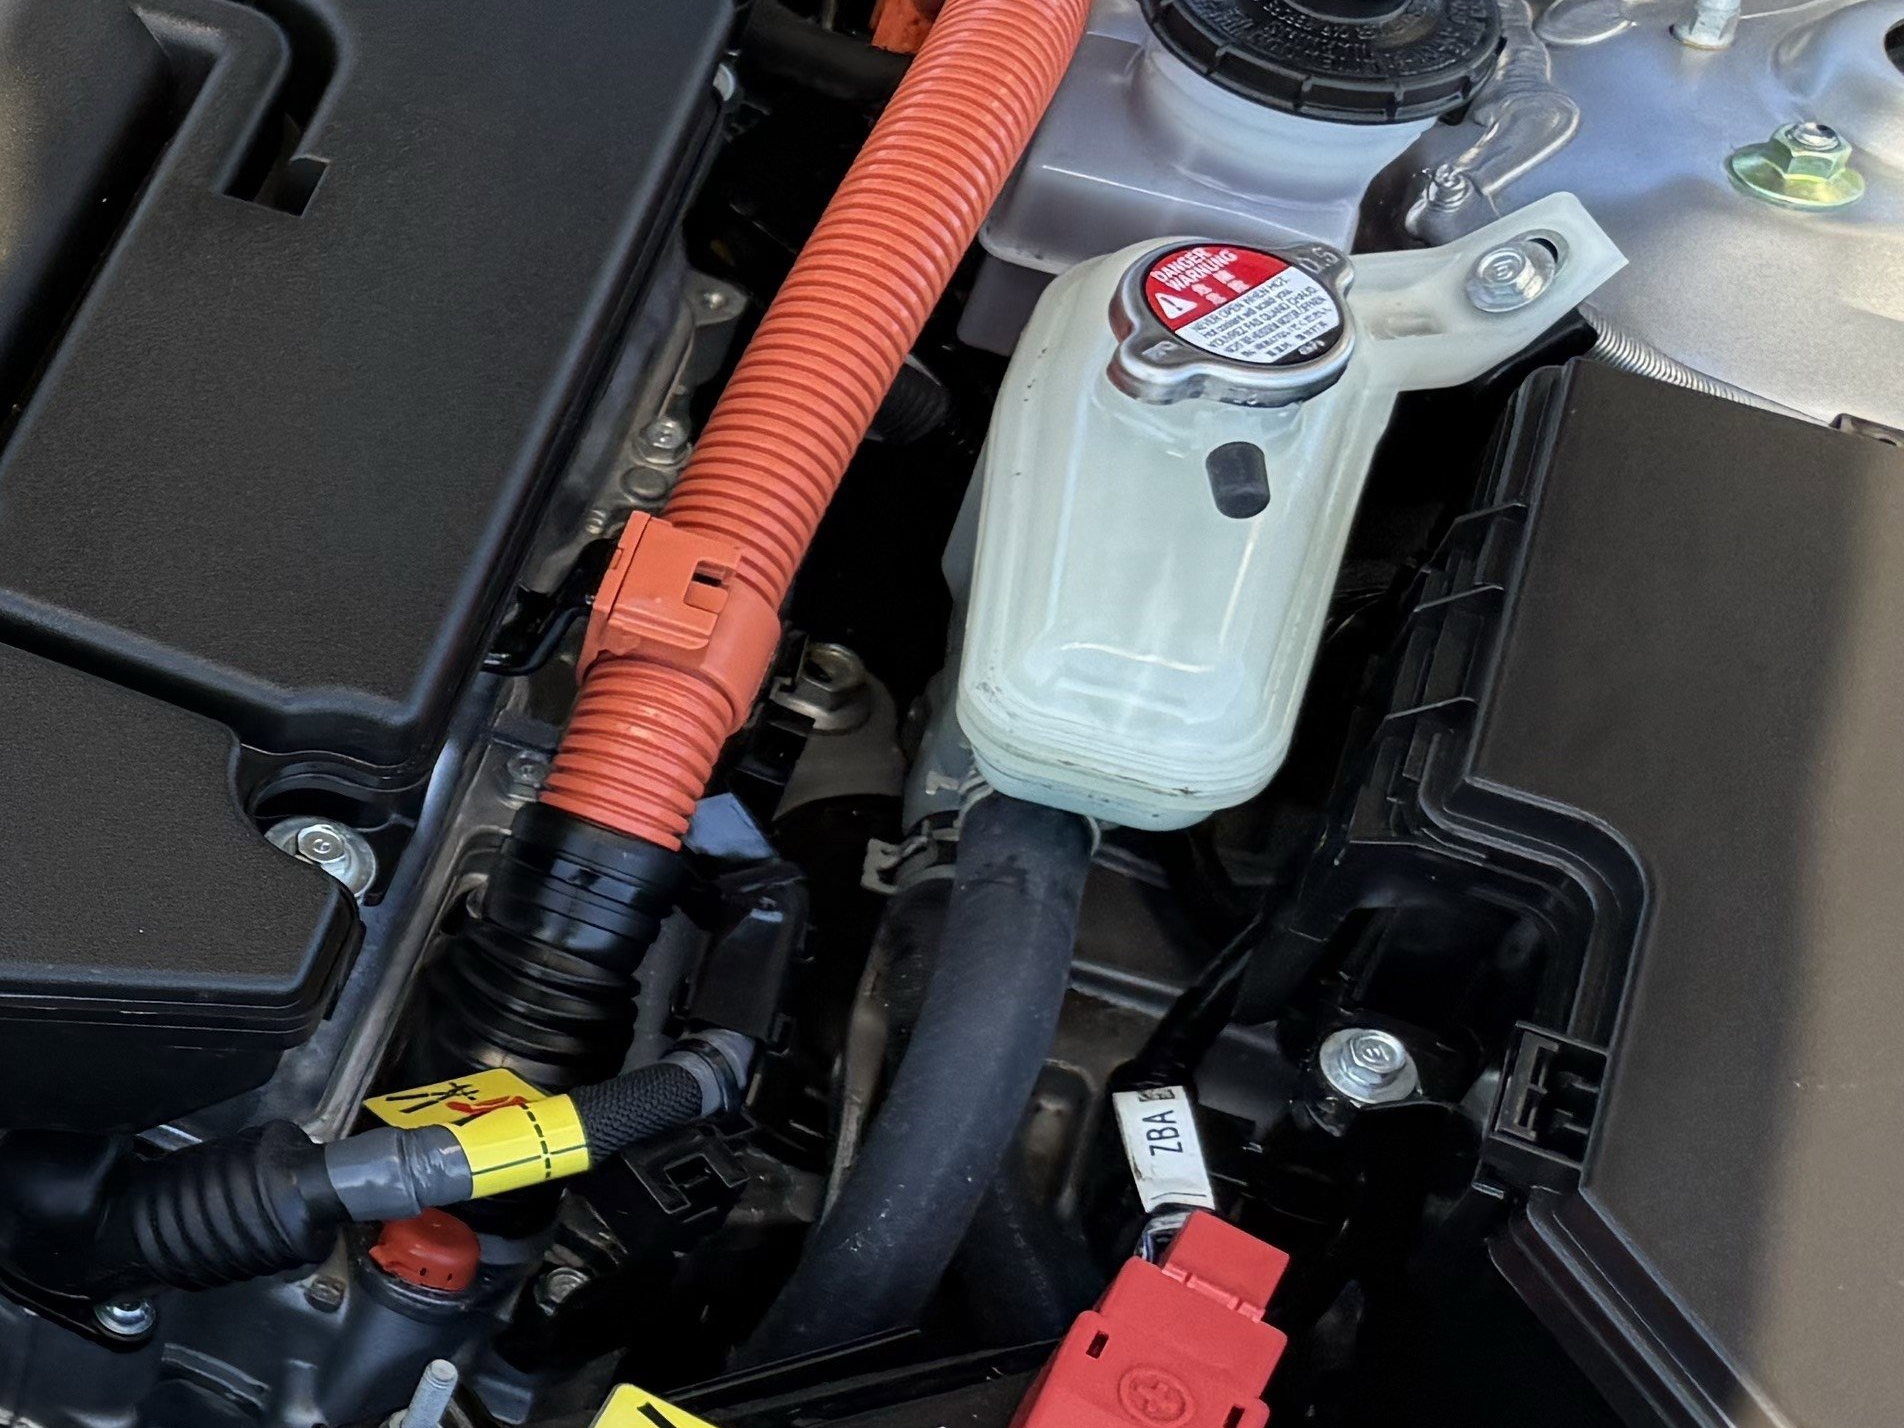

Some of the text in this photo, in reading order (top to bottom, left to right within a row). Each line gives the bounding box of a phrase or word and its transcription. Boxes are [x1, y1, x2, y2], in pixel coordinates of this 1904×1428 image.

[1149, 246, 1212, 283] DANGER
[1164, 248, 1238, 291] WARNUNG
[1142, 1109, 1183, 1157] ZBA
